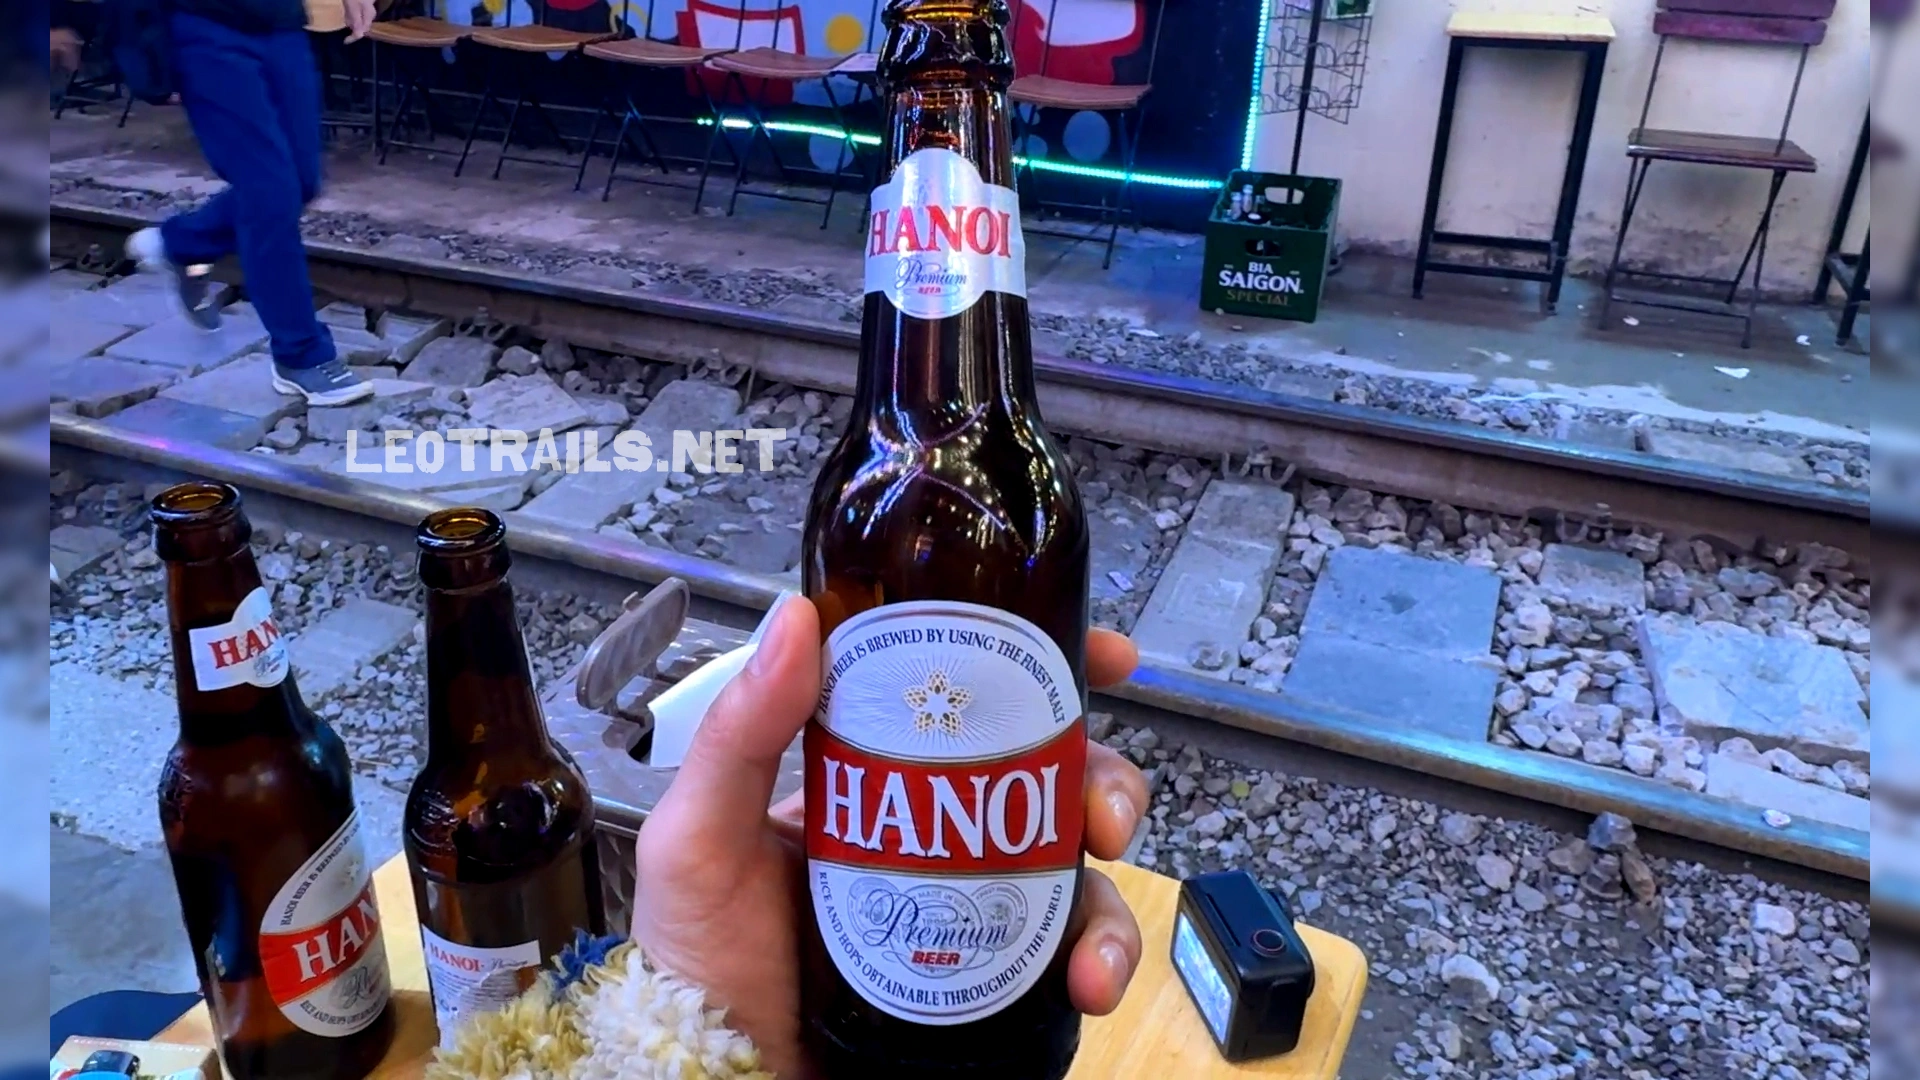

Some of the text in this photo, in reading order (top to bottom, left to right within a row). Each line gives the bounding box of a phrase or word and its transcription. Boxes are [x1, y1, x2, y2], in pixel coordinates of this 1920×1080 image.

[868, 205, 1011, 258] HANOI
[895, 258, 967, 290] Premium
[1218, 270, 1301, 294] SAIGON
[1248, 261, 1274, 274] BIA
[1226, 289, 1289, 305] SPECIAL
[819, 628, 1065, 724] HANOI BEER IS BREWED BY USING THE FINEST MALT
[823, 755, 1059, 859] HANOI
[863, 888, 1008, 948] Premium
[819, 872, 832, 904] RICE
[826, 904, 843, 936] AND
[838, 932, 863, 968] HOPS
[861, 961, 940, 1006] OBTAINABLE
[942, 955, 1029, 1006] THROUGHOUT
[1024, 930, 1047, 961] THE
[1040, 884, 1063, 936] WORLD
[430, 942, 480, 972] HANOI
[911, 950, 961, 966] BEER
